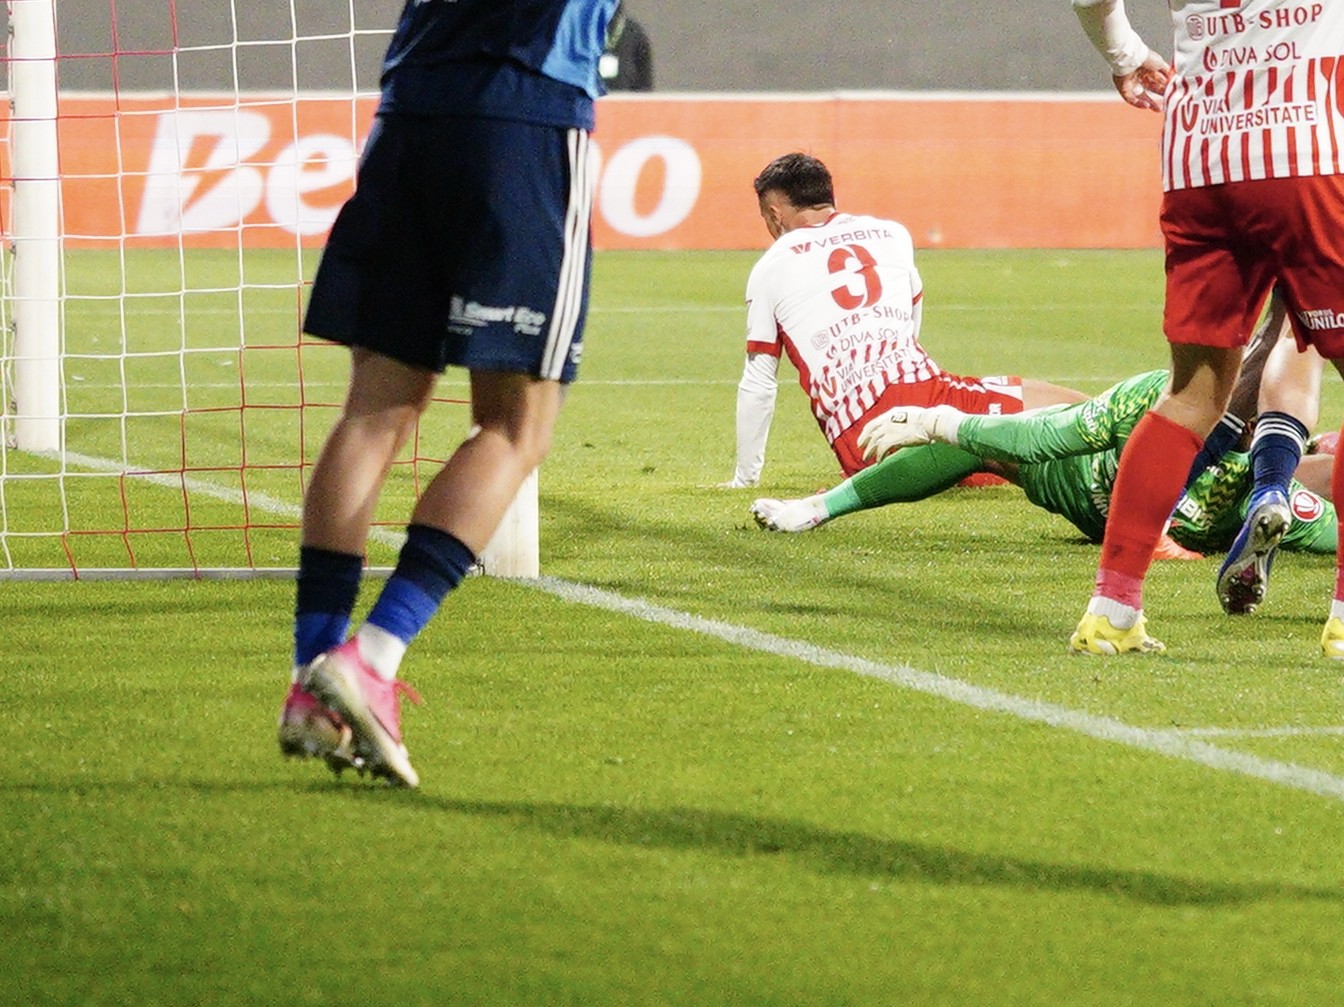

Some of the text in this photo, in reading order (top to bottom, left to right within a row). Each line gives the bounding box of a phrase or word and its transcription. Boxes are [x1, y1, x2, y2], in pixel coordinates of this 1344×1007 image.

[1221, 42, 1302, 67] DIVA SOL
[1203, 99, 1228, 114] VIA
[1200, 104, 1315, 135] UNIVERSITATE
[814, 229, 892, 248] VERBITA
[827, 243, 883, 310] 3
[840, 330, 874, 352] DIVA
[836, 362, 854, 380] VIA
